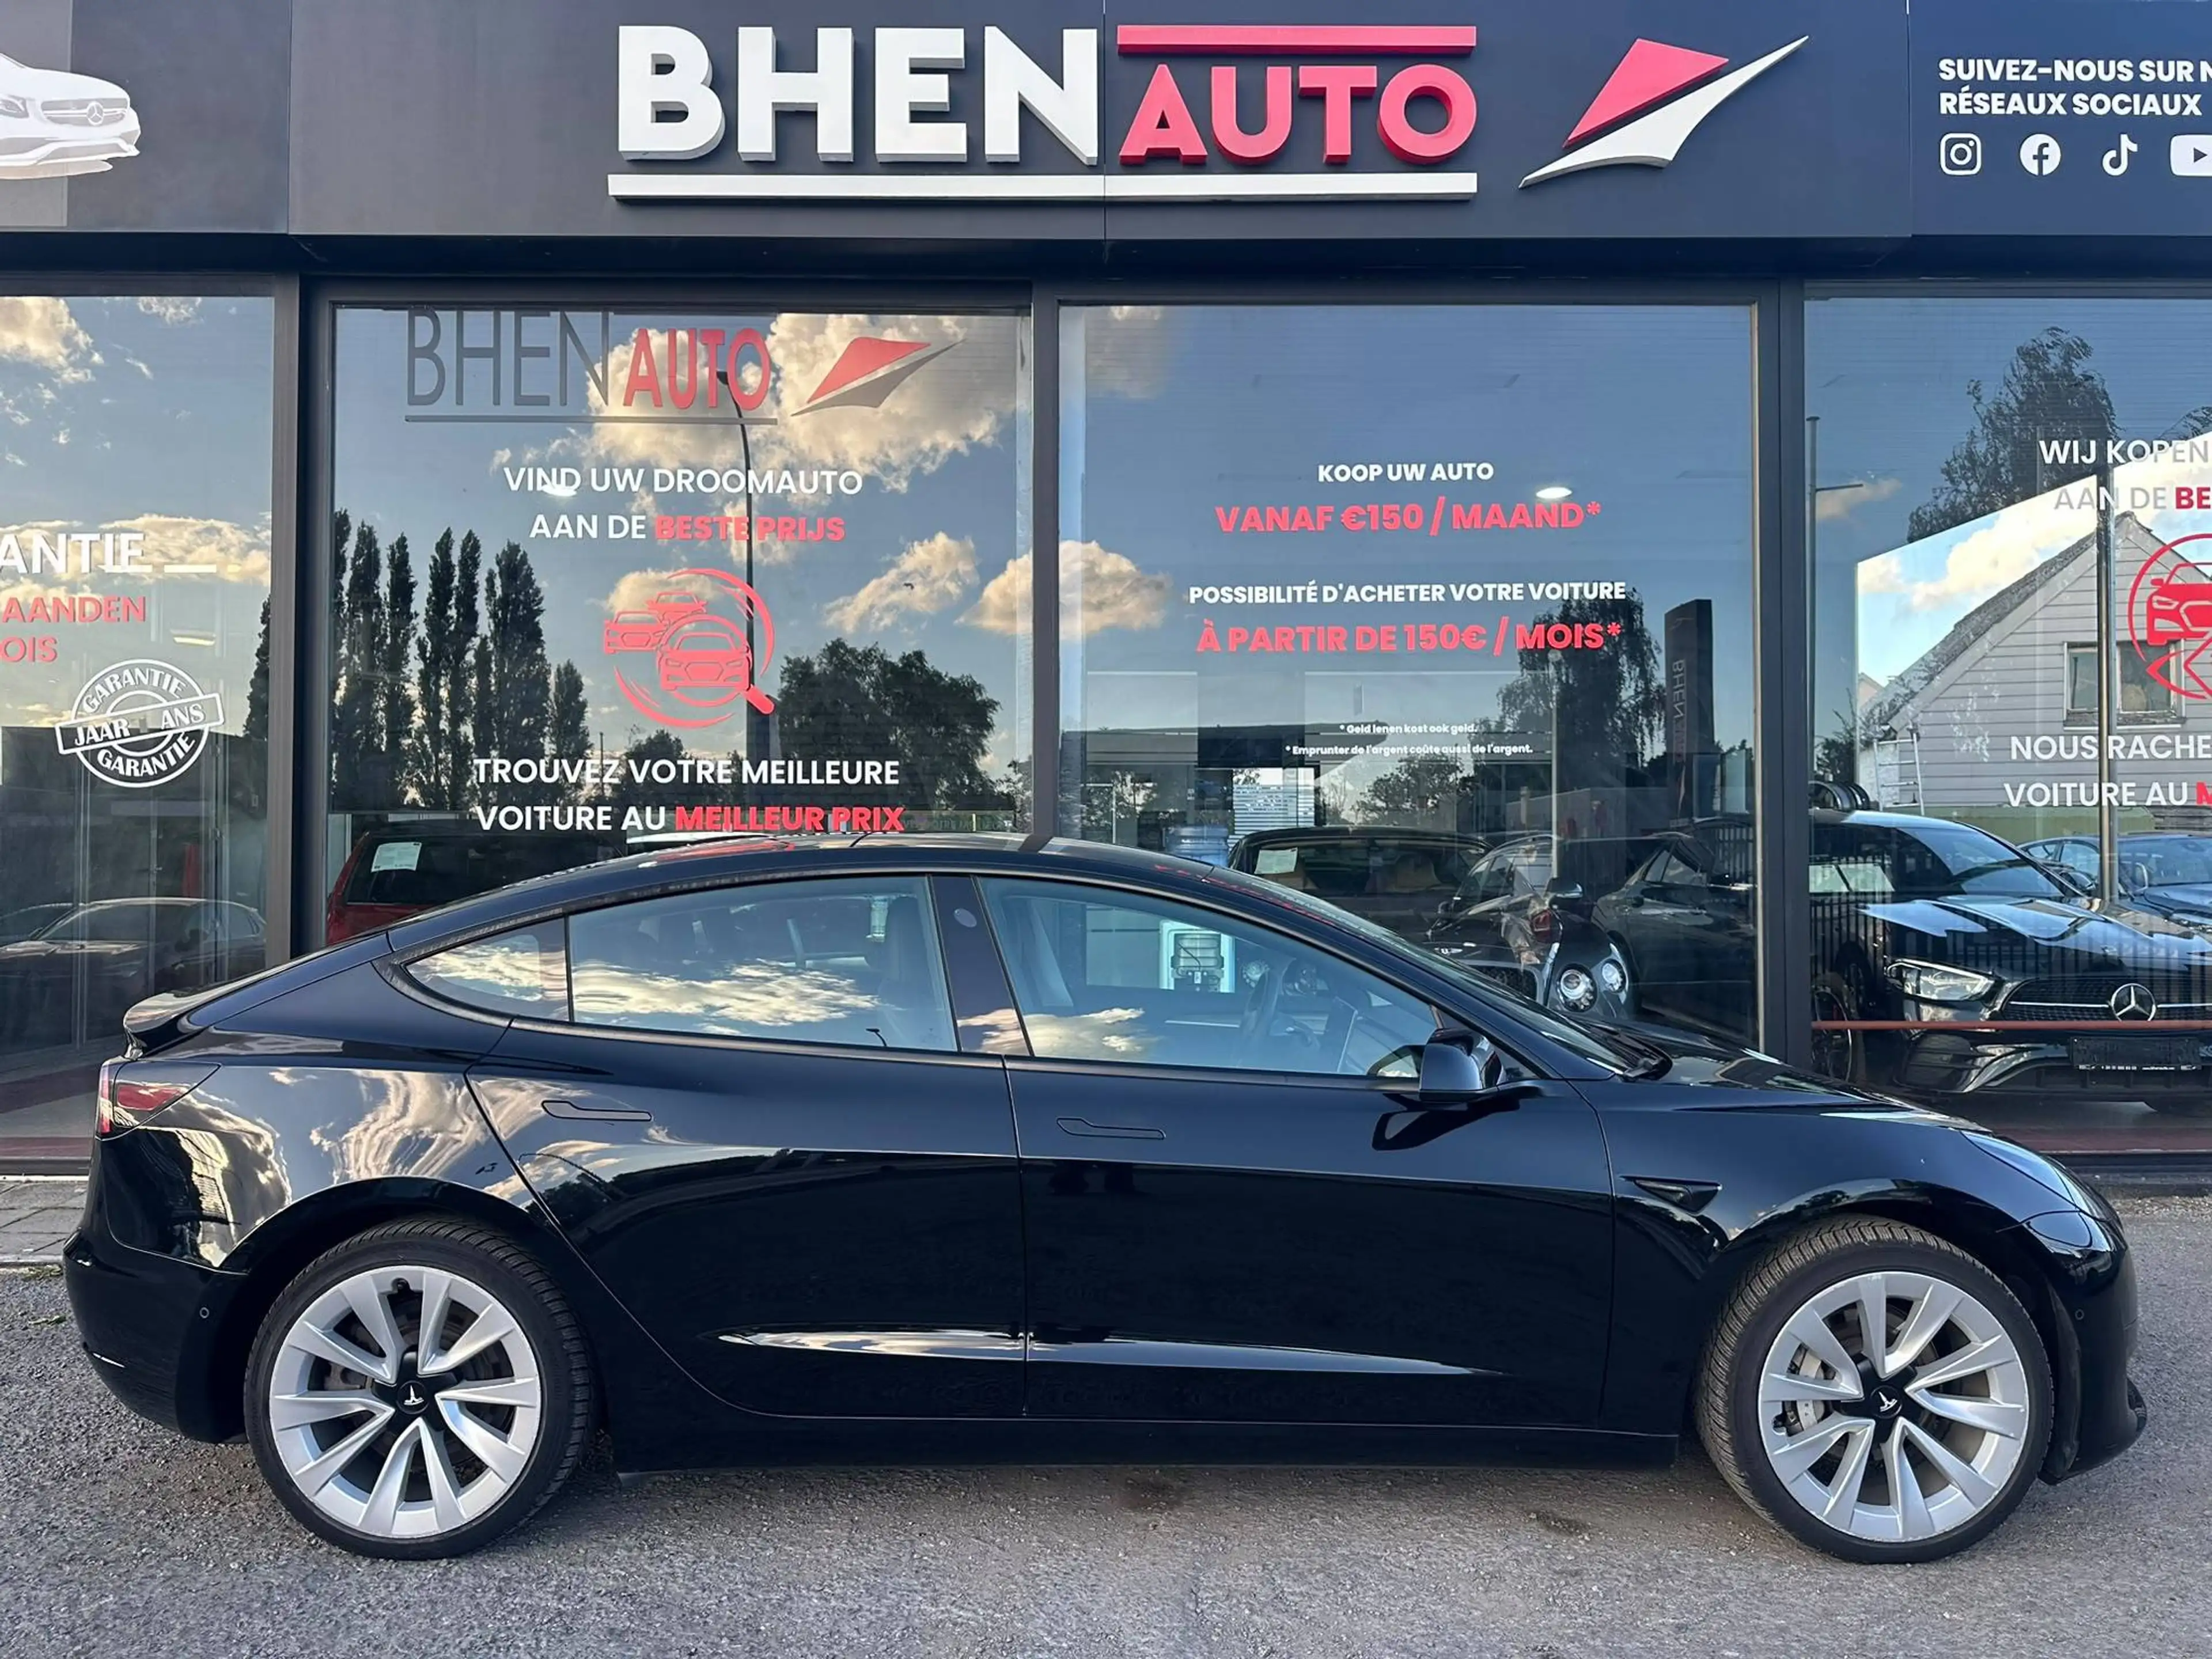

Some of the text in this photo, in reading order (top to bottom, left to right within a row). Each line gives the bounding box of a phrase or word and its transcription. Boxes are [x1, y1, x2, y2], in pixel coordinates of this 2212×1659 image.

[1939, 58, 2134, 82] SUIVEZ-NOUS
[2139, 60, 2194, 82] SUR
[618, 25, 1478, 165] BHEN AUTO
[1940, 85, 2202, 115] RÉSEAUX SOCIAUX
[407, 308, 772, 411] BHEN AUTO
[2039, 440, 2208, 464] WIJ KOPEN
[504, 467, 863, 496] VIND UW DROOMAUTO
[1318, 463, 1494, 483] KOOP UW AUTO
[2054, 487, 2119, 510] AAN
[2131, 487, 2166, 509] DE
[529, 515, 845, 541] AAN DE BESTE PRIJS
[1215, 506, 1334, 532] VANAF
[1340, 503, 1423, 531] €150
[1429, 496, 1445, 536] /
[1190, 580, 1626, 604] POSSIBILITÉ D'ACHETER VOTRE VOITURE
[1196, 620, 1221, 653] À
[1229, 626, 1347, 653] PARTIR
[1355, 626, 1397, 652] DE
[1404, 624, 1487, 651] 150€
[1493, 617, 1509, 656] /
[83, 668, 186, 713] GARANTIE
[74, 703, 205, 745] JAAR ANS
[1347, 725, 1370, 734] Geld
[1373, 725, 1403, 733] lenen
[1404, 725, 1428, 733] kost
[1430, 725, 1449, 733] ook
[1450, 724, 1478, 734] geld.
[97, 732, 195, 777] GARANTIE
[1293, 745, 1349, 756] Emprunter
[1351, 745, 1365, 754] de
[1366, 745, 1408, 755] l'argent
[1410, 744, 1440, 753] coûte
[1442, 744, 1470, 753] aussi
[1472, 744, 1486, 753] de
[1487, 744, 1533, 755] l'argent.
[2011, 735, 2211, 760] NOUS RACHE
[474, 759, 899, 785] TROUVEZ VOTRE MEILLEURE
[2003, 782, 2137, 806] VOITURE
[2145, 782, 2188, 805] AU
[476, 805, 612, 832] VOITURE
[622, 806, 665, 831] AU
[675, 807, 822, 832] MEILLEUR
[833, 808, 904, 832] PRIX
